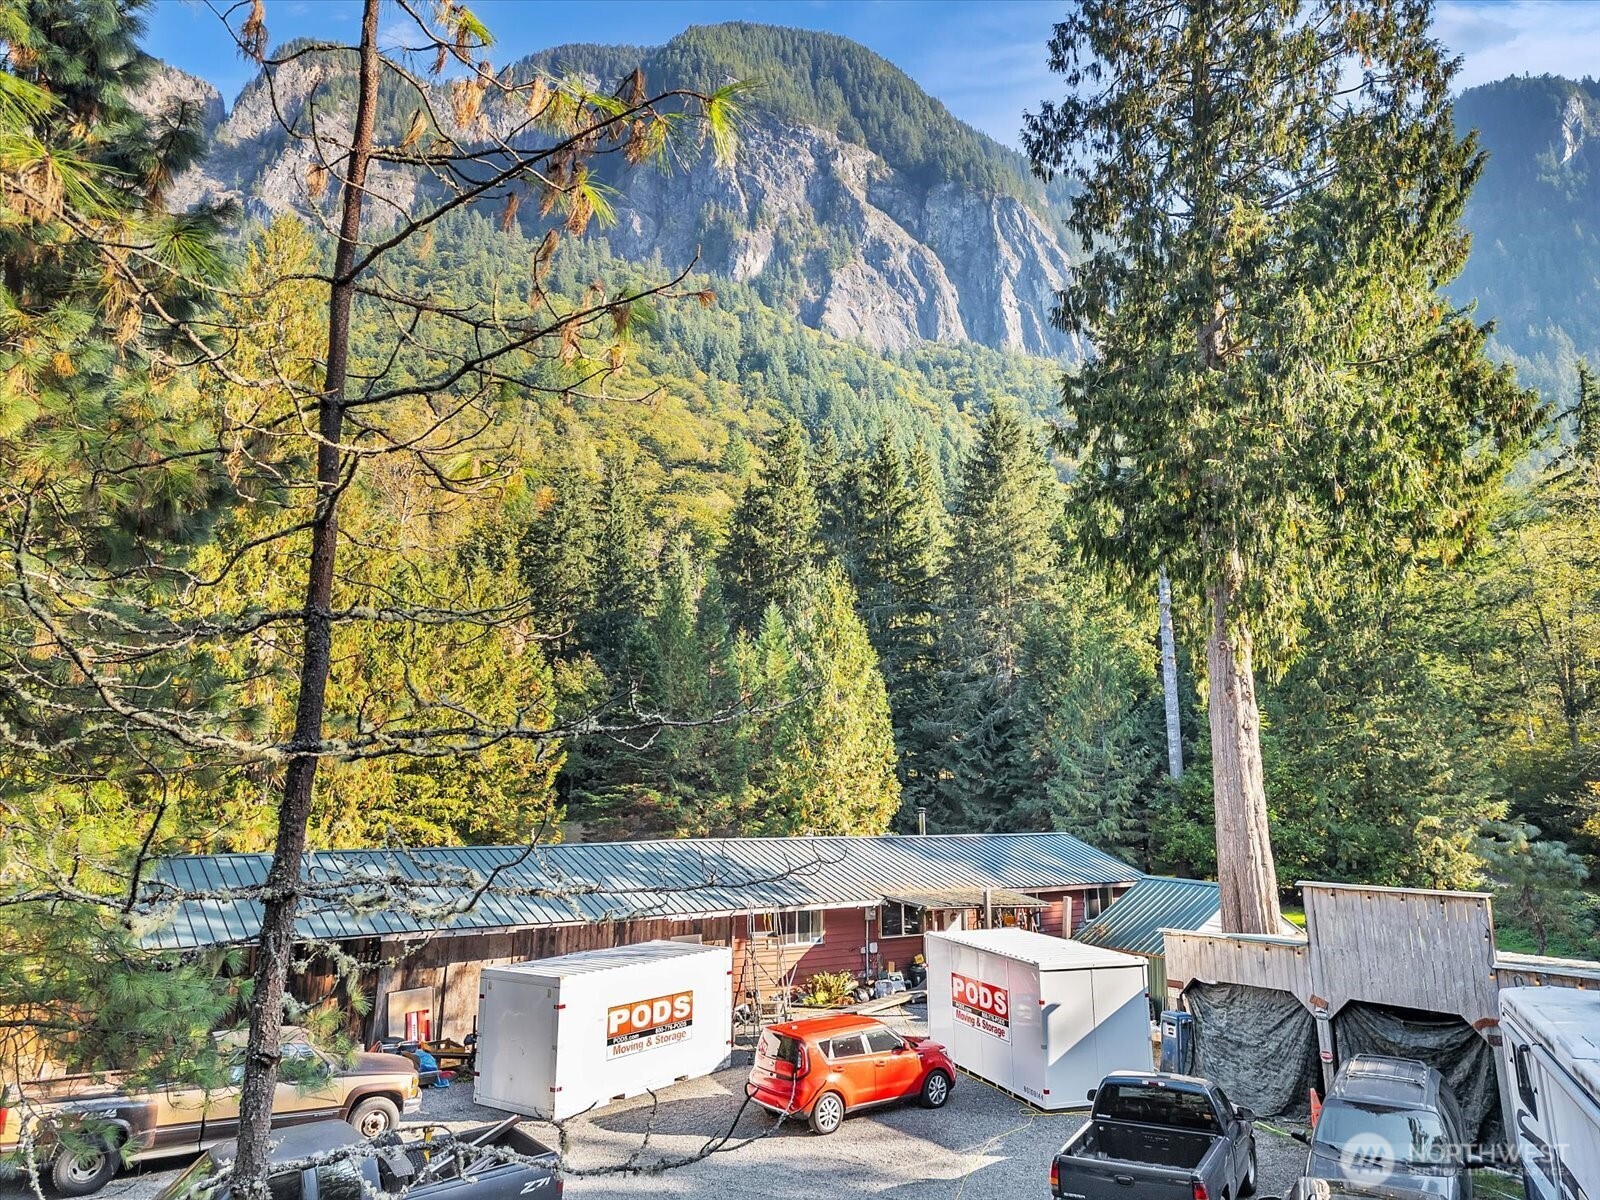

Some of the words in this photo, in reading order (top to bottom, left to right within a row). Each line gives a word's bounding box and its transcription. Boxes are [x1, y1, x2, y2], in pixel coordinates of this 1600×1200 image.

[952, 976, 1007, 1015] PODS
[608, 995, 691, 1034] PODS
[955, 1009, 975, 1027] Moving
[976, 1017, 981, 1027] &
[982, 1019, 1006, 1037] Storage
[612, 1040, 644, 1055] Moving
[646, 1036, 652, 1047] &
[655, 1030, 686, 1045] Storage
[520, 1176, 551, 1195] Z71
